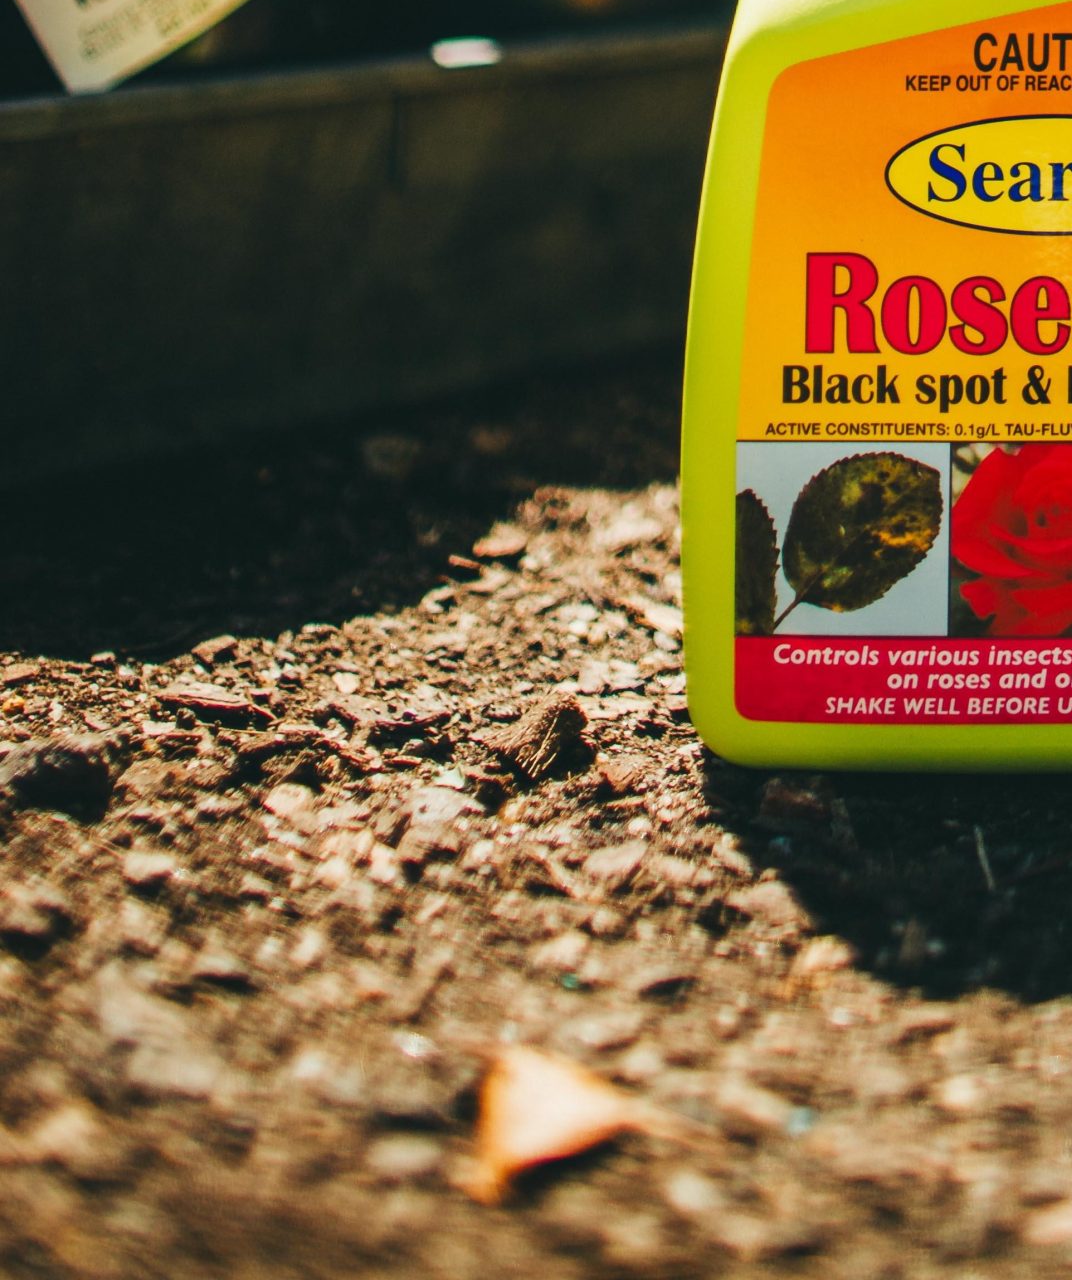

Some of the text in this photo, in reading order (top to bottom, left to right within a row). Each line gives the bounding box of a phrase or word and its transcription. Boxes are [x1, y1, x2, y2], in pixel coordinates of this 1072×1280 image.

[905, 75, 952, 91] KEEP
[955, 75, 992, 91] OUT
[997, 75, 1020, 91] OF
[805, 252, 1071, 355] Rose
[782, 364, 900, 405] Black
[915, 367, 1007, 412] spot
[1021, 366, 1053, 405] &
[765, 422, 821, 436] ACTIVE
[826, 422, 950, 436] CONSTITUENTS:
[954, 422, 1000, 438] 0.1g/L
[773, 644, 879, 665] Controls
[887, 645, 980, 665] various
[988, 645, 1072, 665] insects
[887, 672, 921, 689] on
[926, 672, 991, 689] roses
[999, 668, 1047, 689] and
[825, 697, 896, 715] SHAKE
[903, 697, 960, 715] WELL
[967, 696, 1050, 714] BEFORE
